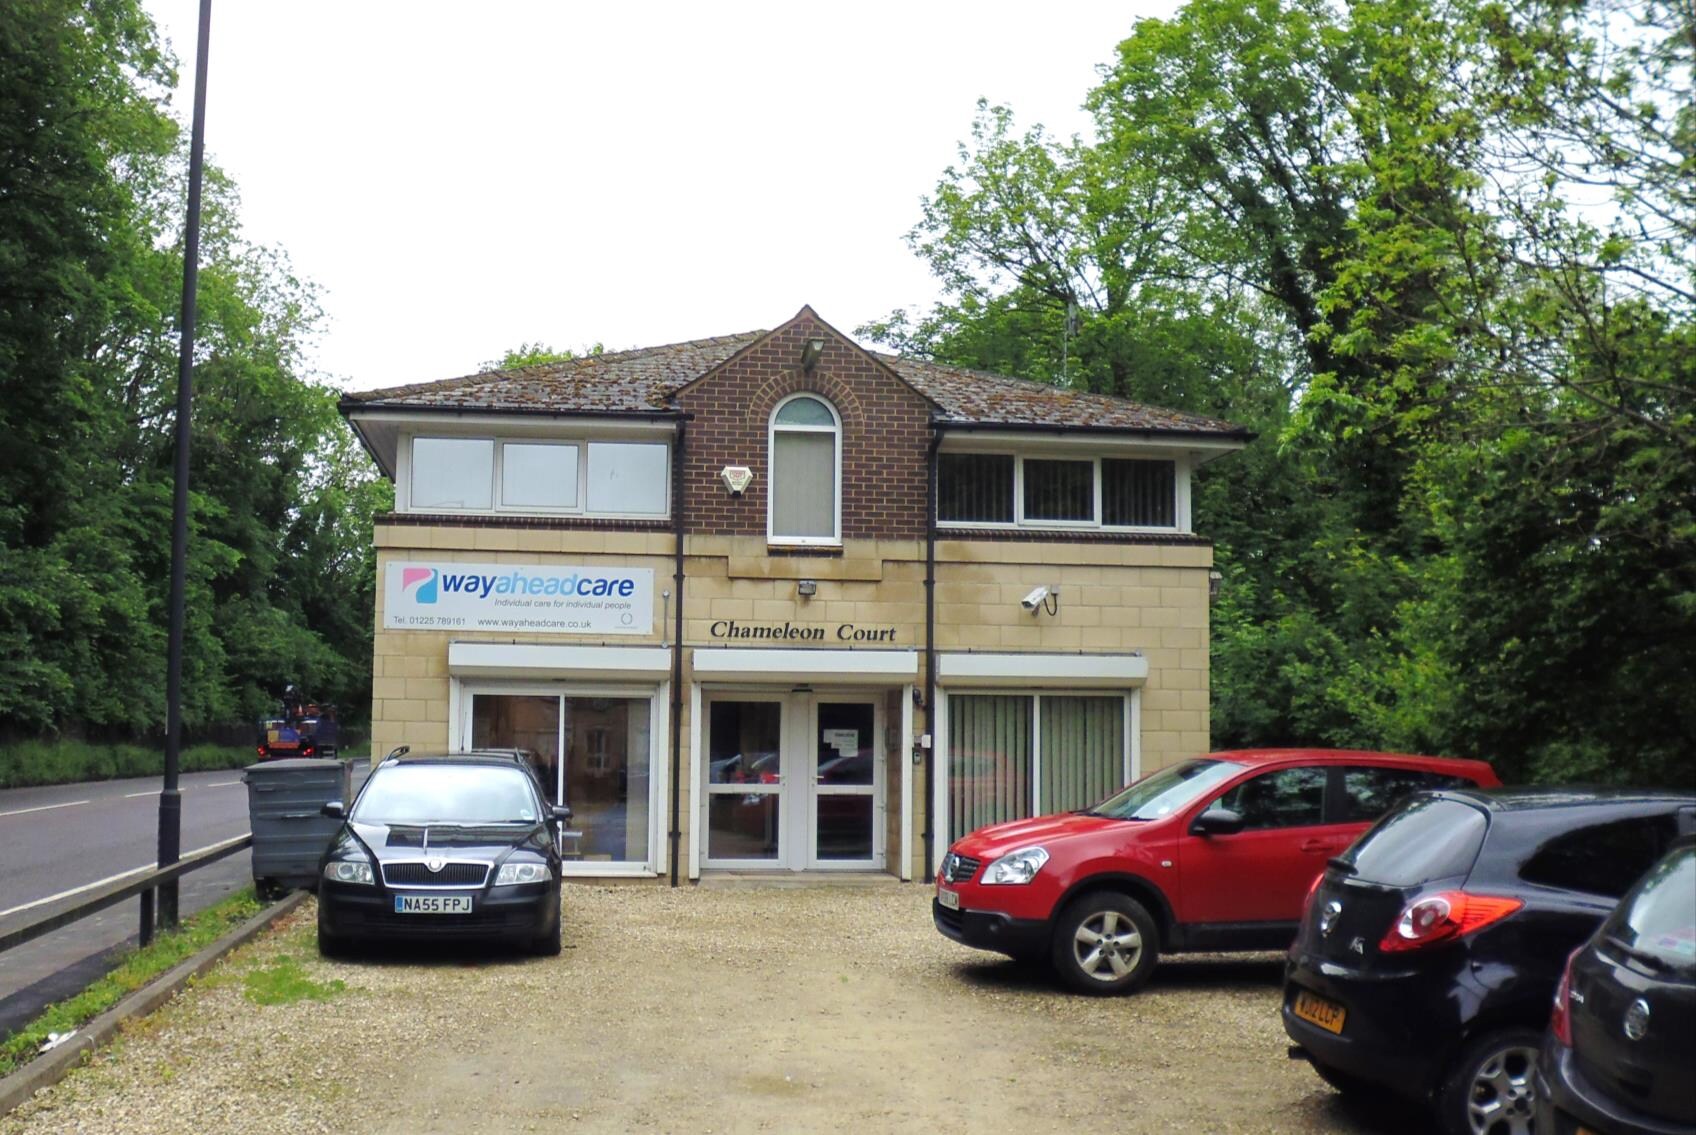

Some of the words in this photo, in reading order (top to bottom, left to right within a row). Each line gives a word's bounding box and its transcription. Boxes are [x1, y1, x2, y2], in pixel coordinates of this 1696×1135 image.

[442, 572, 634, 598] wayaheadcare
[494, 599, 532, 608] Individual
[553, 600, 564, 608] for
[565, 600, 602, 609] individual
[604, 602, 632, 610] people
[409, 616, 434, 625] 01225
[477, 618, 592, 629] www.wayaheadcare.co.uk
[710, 619, 825, 640] Chameleon
[836, 624, 896, 641] Court
[403, 898, 439, 911] NA55
[443, 898, 470, 912] FPJ
